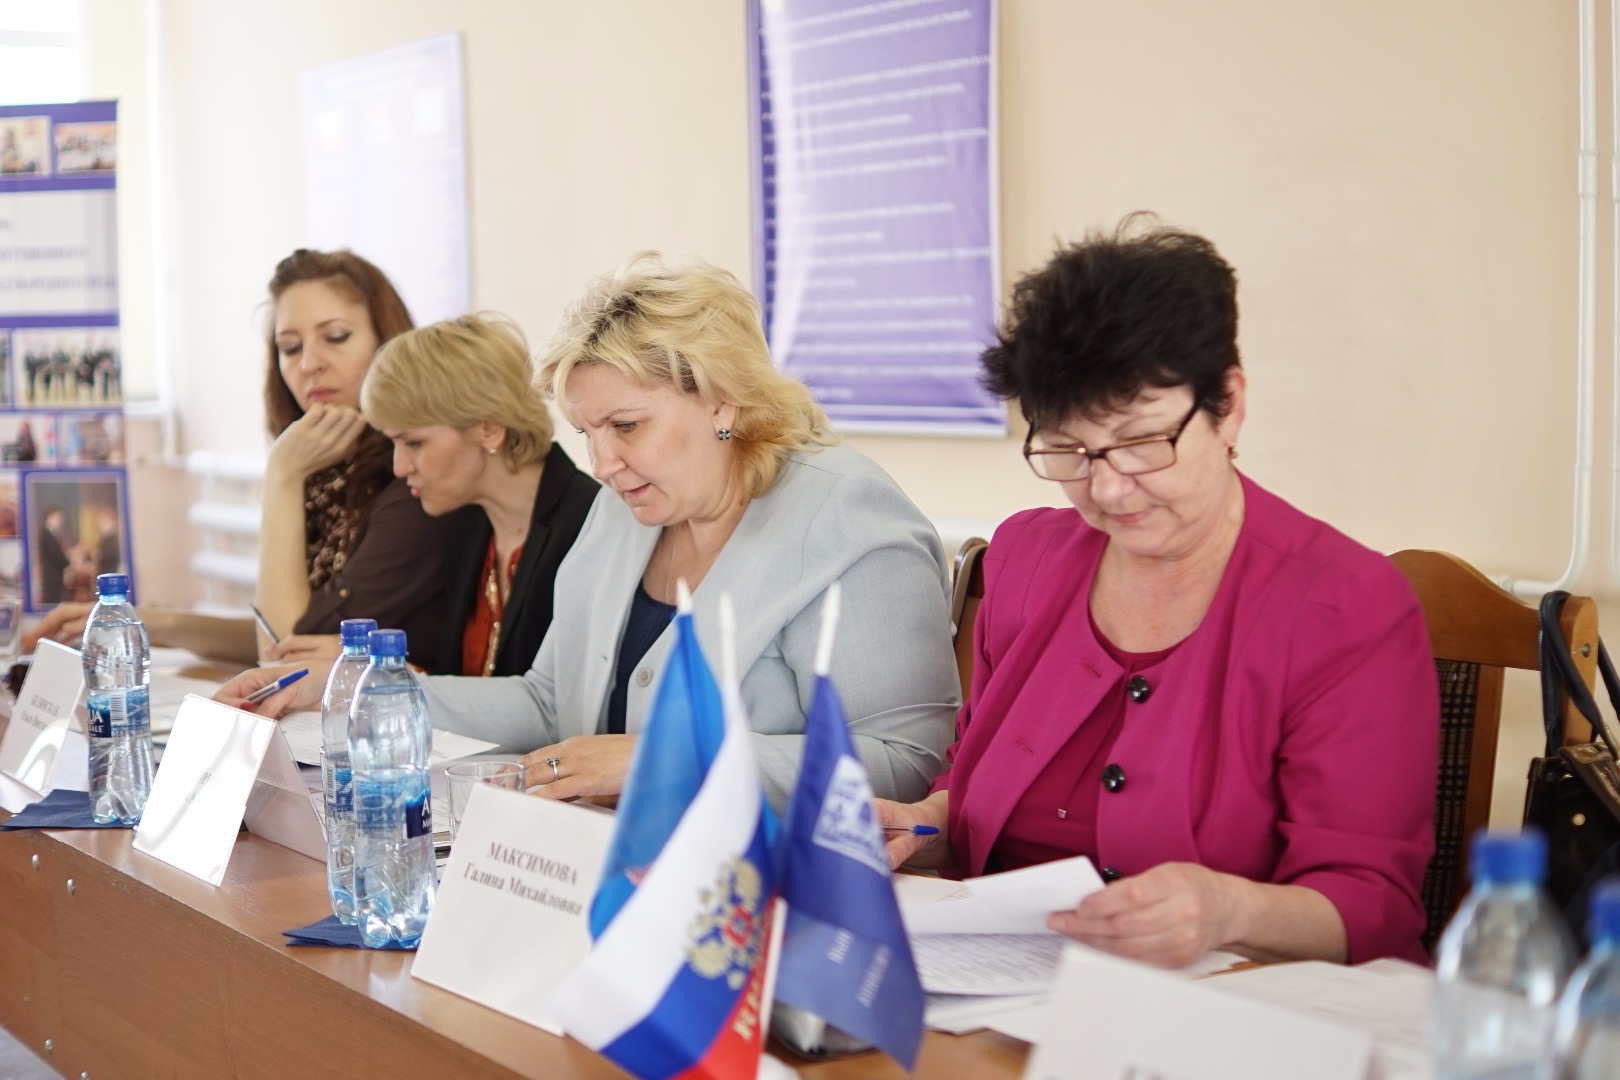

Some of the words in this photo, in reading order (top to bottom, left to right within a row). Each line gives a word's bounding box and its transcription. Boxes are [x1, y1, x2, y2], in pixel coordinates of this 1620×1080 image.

[486, 841, 578, 886] МАКСИМОВА
[463, 862, 505, 890] Галина
[508, 876, 583, 917] Михайловна
